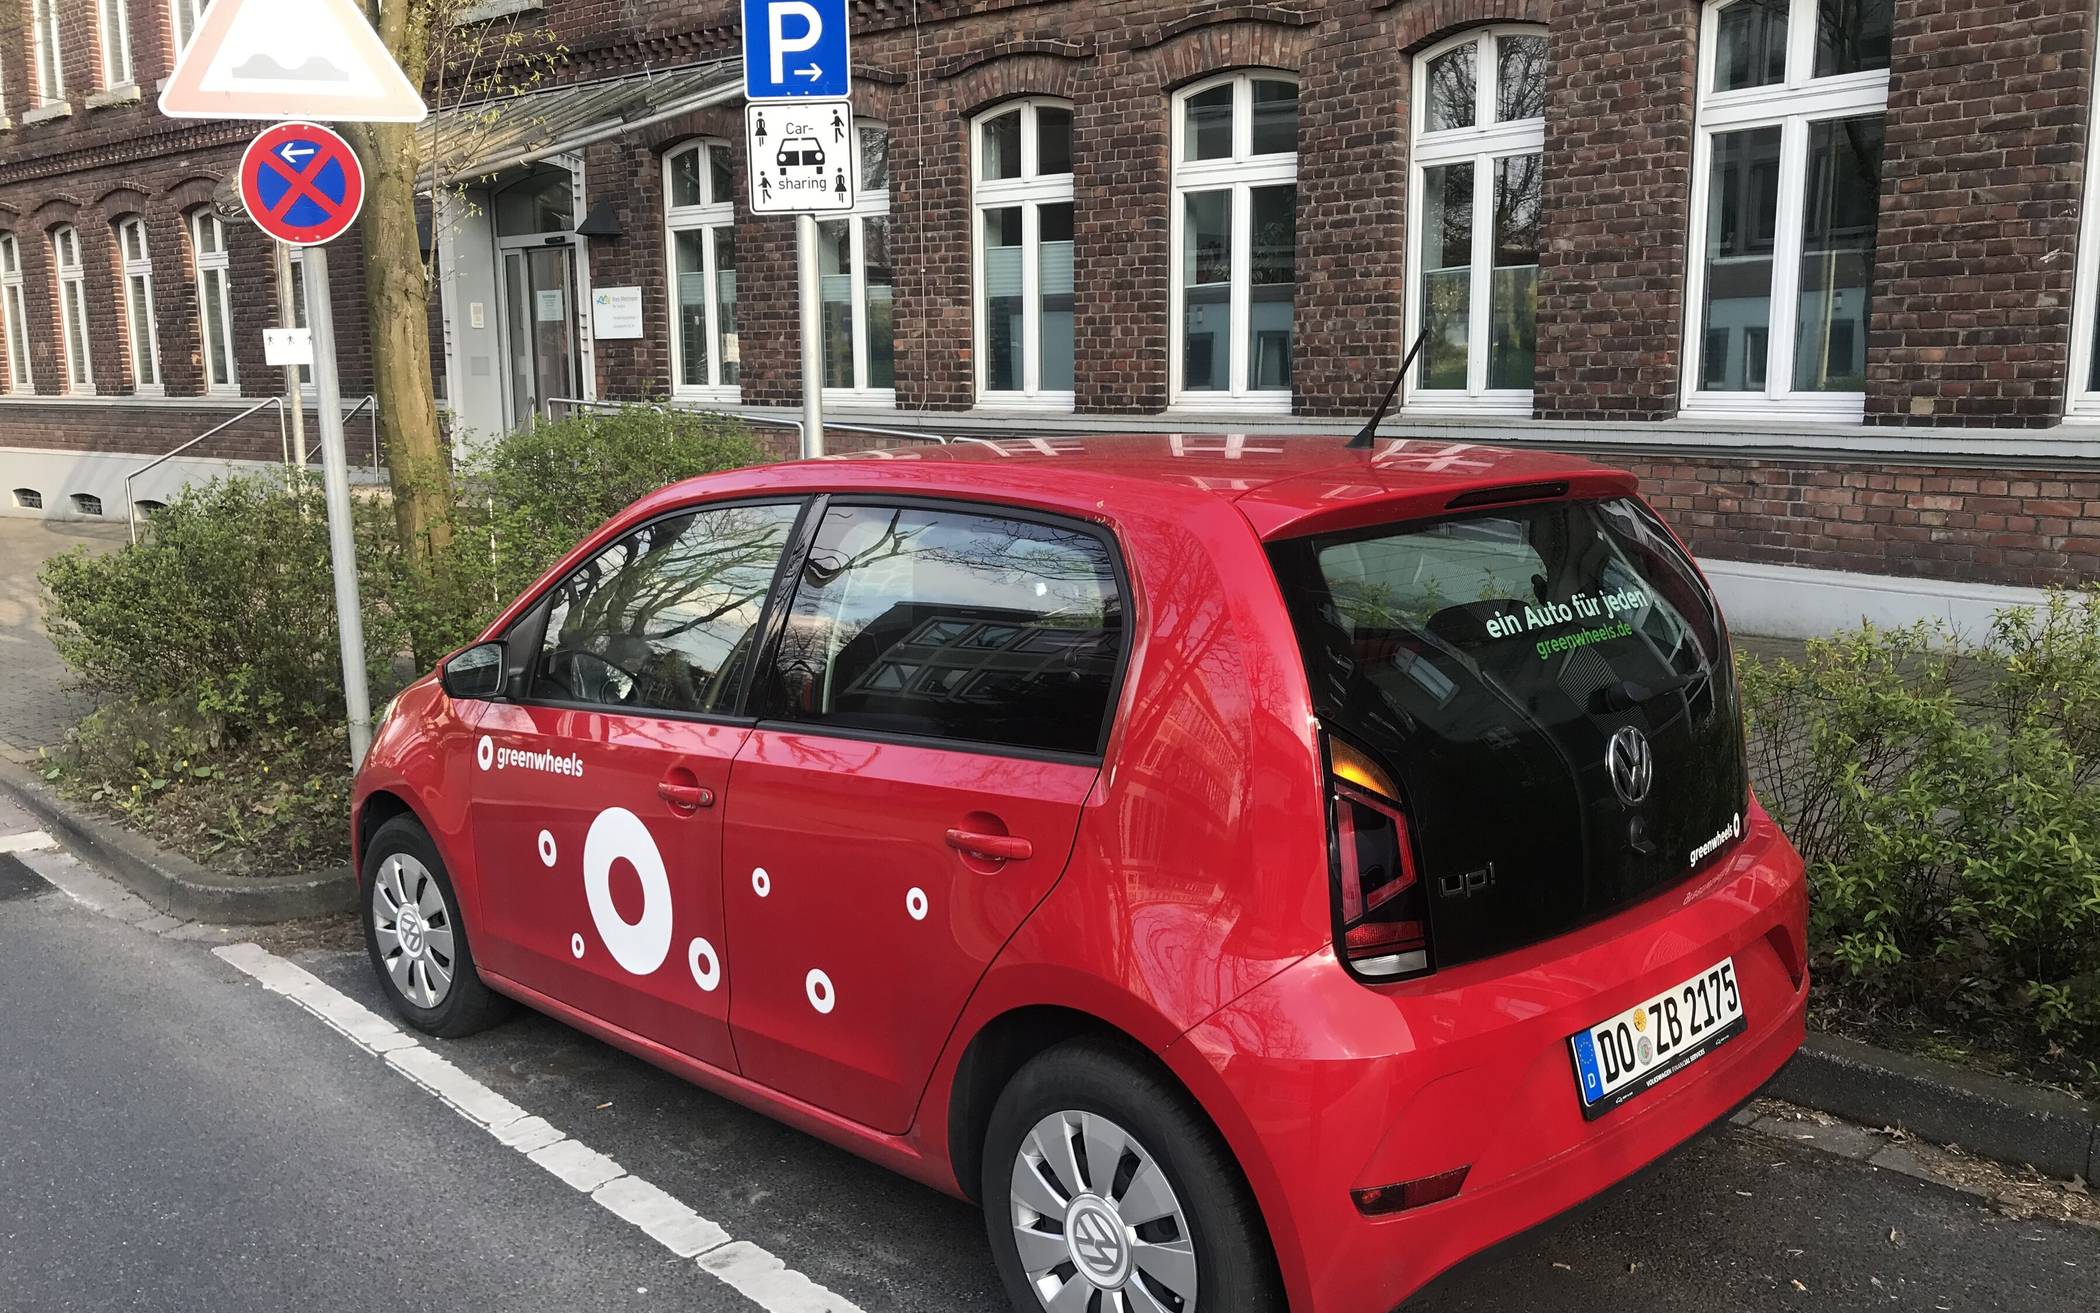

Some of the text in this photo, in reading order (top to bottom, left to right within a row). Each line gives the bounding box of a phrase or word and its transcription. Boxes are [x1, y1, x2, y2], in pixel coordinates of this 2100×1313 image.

[768, 1, 823, 84] P
[785, 122, 814, 135] Car-
[778, 177, 827, 192] sharing
[1486, 587, 1649, 639] ein Auto für jeden
[1536, 620, 1633, 660] greenwheels.de
[497, 747, 584, 777] greenwheels
[1690, 822, 1733, 868] greenwheels
[1439, 862, 1496, 898] up!
[1597, 1022, 1636, 1083] DO
[1649, 997, 1683, 1056] ZB
[1683, 963, 1738, 1037] 2175
[1587, 1072, 1597, 1089] D
